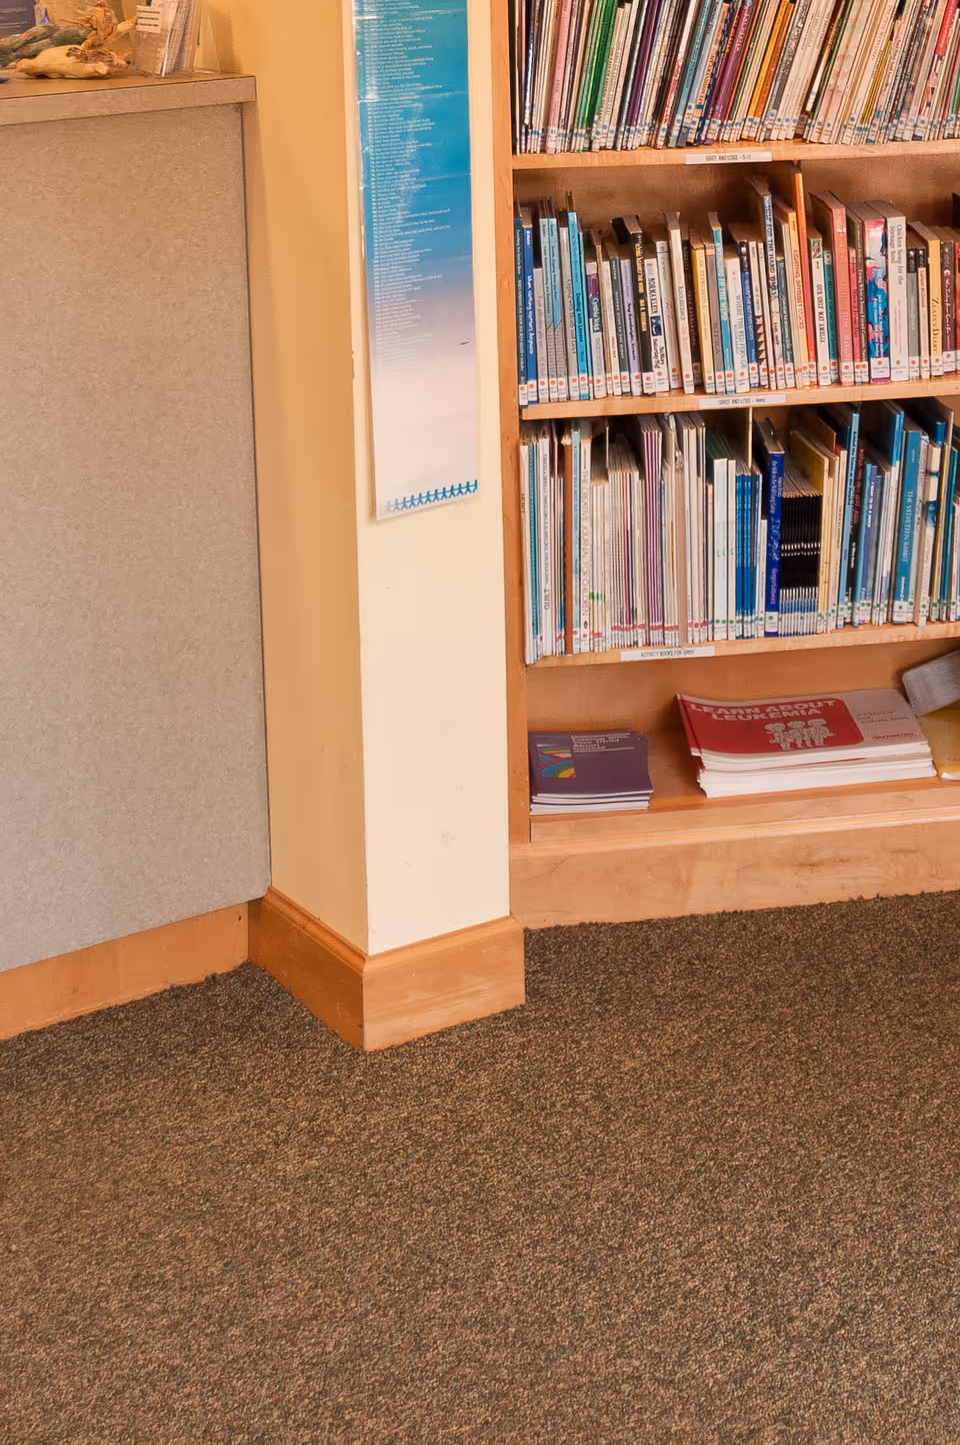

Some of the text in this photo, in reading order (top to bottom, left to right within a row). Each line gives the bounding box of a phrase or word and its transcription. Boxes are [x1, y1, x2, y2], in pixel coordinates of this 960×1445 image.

[931, 298, 940, 352] ZLATA'S DIARY
[690, 700, 836, 715] LEARN ABOUT
[711, 708, 822, 721] LEUKEMIA
